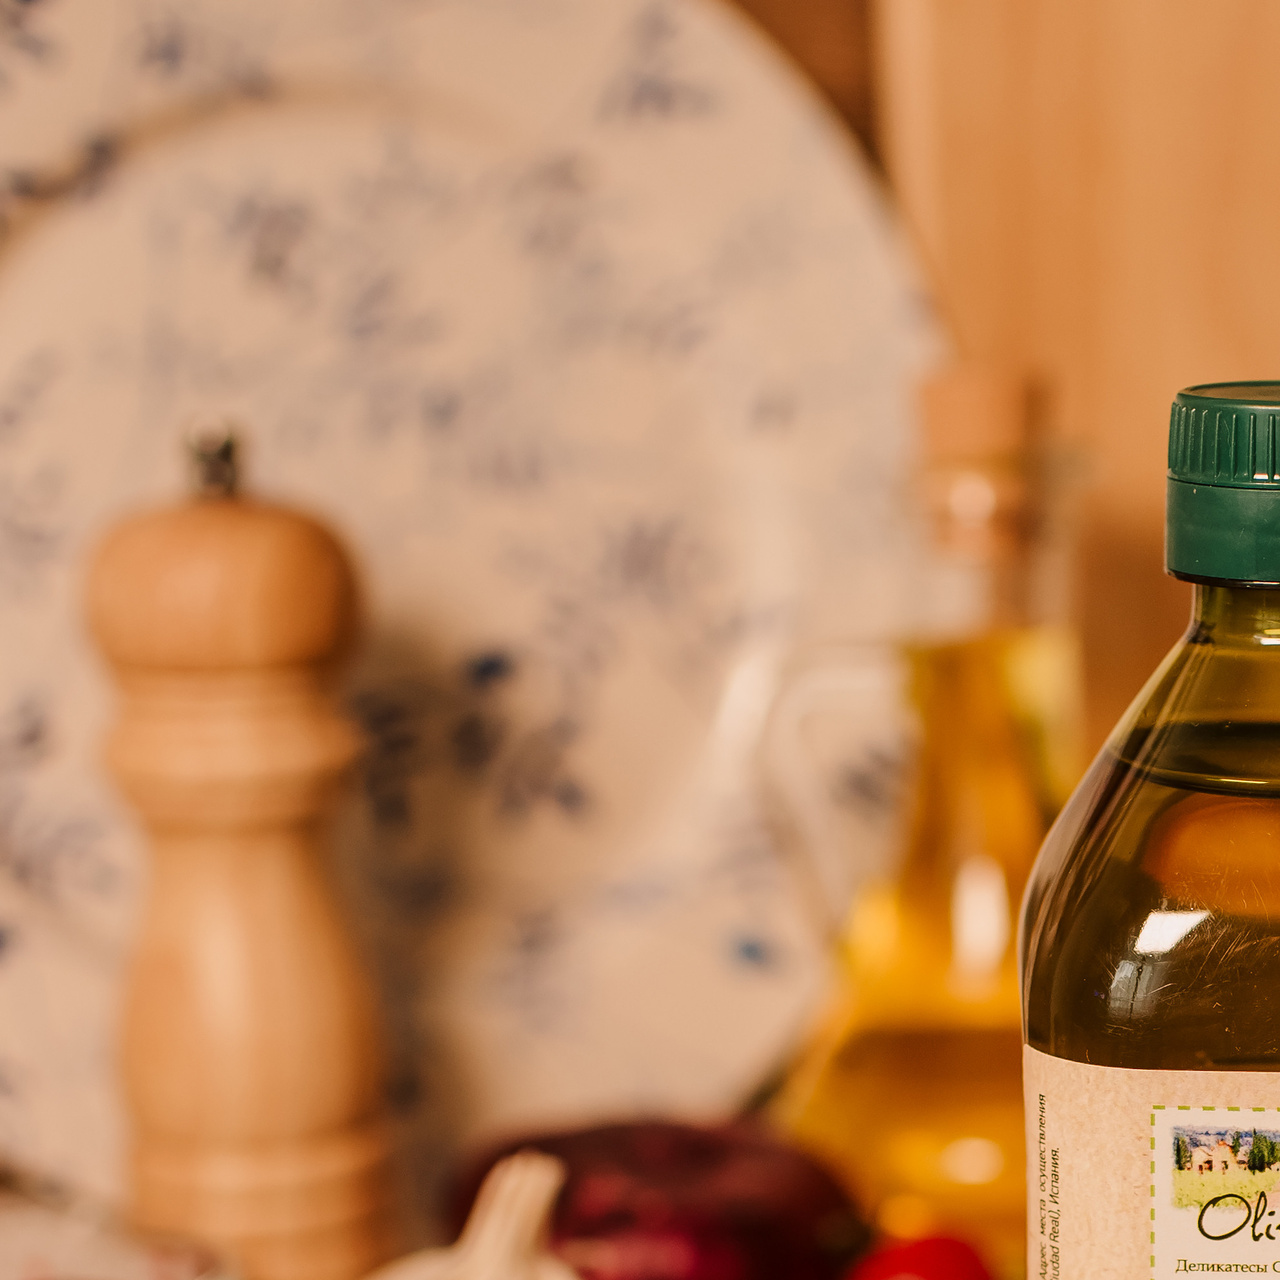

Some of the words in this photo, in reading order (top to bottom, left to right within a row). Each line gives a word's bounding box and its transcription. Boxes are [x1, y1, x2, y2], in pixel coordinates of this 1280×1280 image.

[1037, 1093, 1048, 1193] осуществления
[1048, 1147, 1060, 1205] Испания.
[1039, 1199, 1047, 1236] места
[1048, 1209, 1061, 1243] Real),
[1038, 1242, 1049, 1280] Адрес
[1175, 1259, 1268, 1273] Деликатесы
